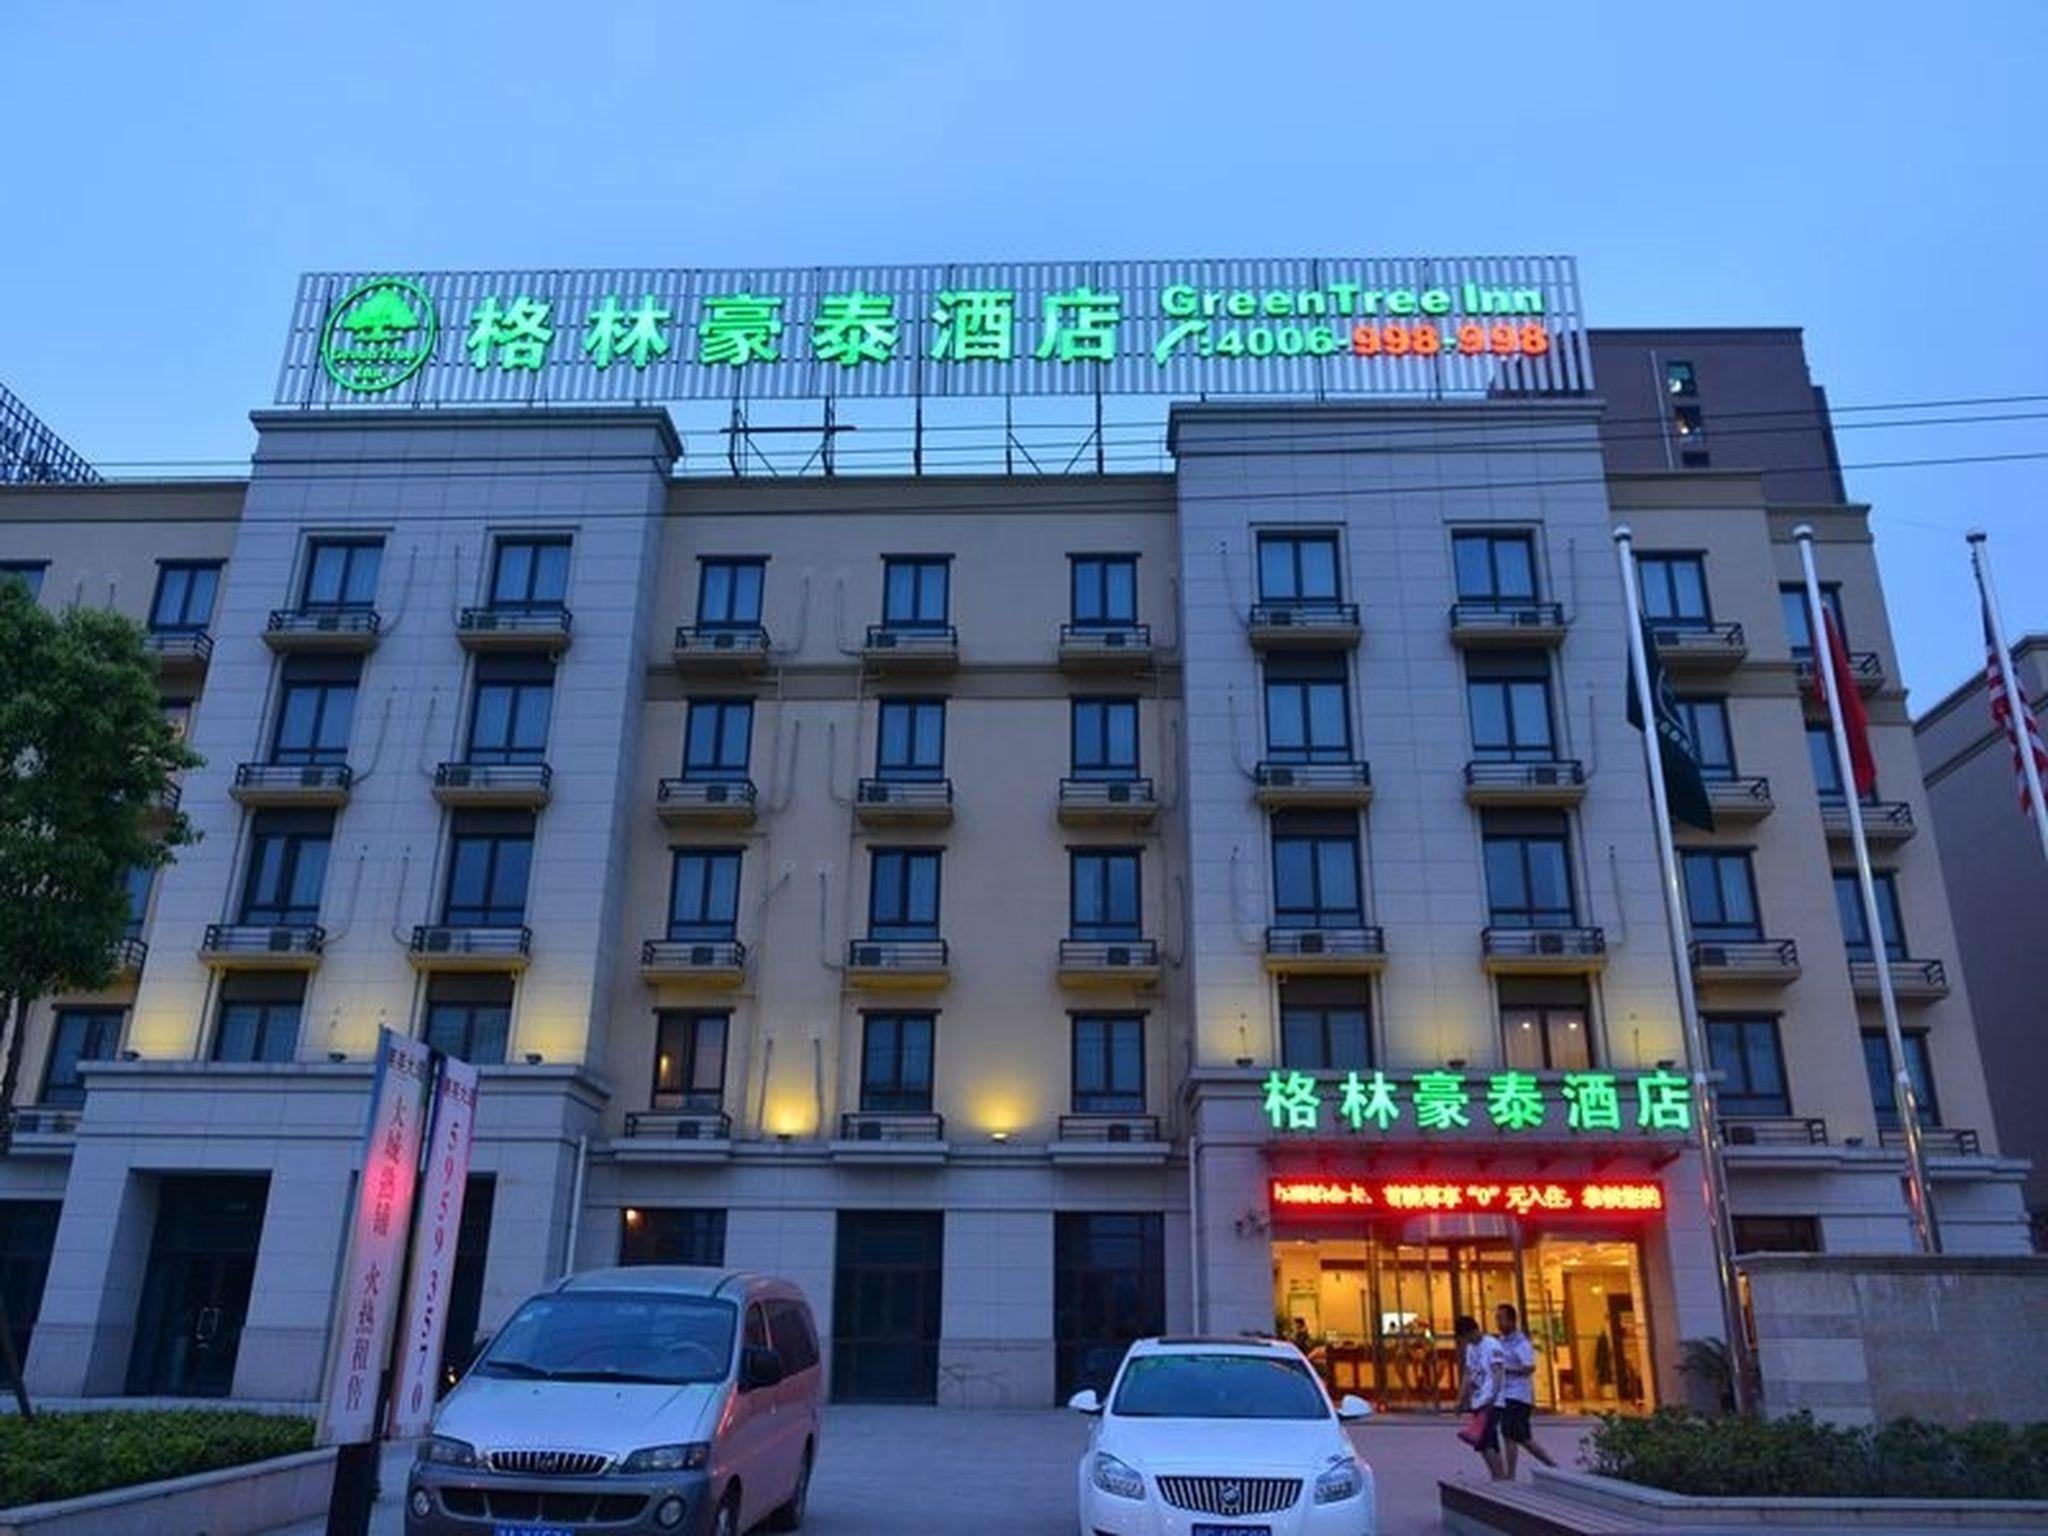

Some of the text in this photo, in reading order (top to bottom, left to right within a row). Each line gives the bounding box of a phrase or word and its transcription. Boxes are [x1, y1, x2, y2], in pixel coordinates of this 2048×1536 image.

[467, 286, 1121, 370] 格林豪泰酒店
[1161, 281, 1544, 317] GreenTree Inn
[1262, 1070, 1692, 1130] 格林豪泰酒店
